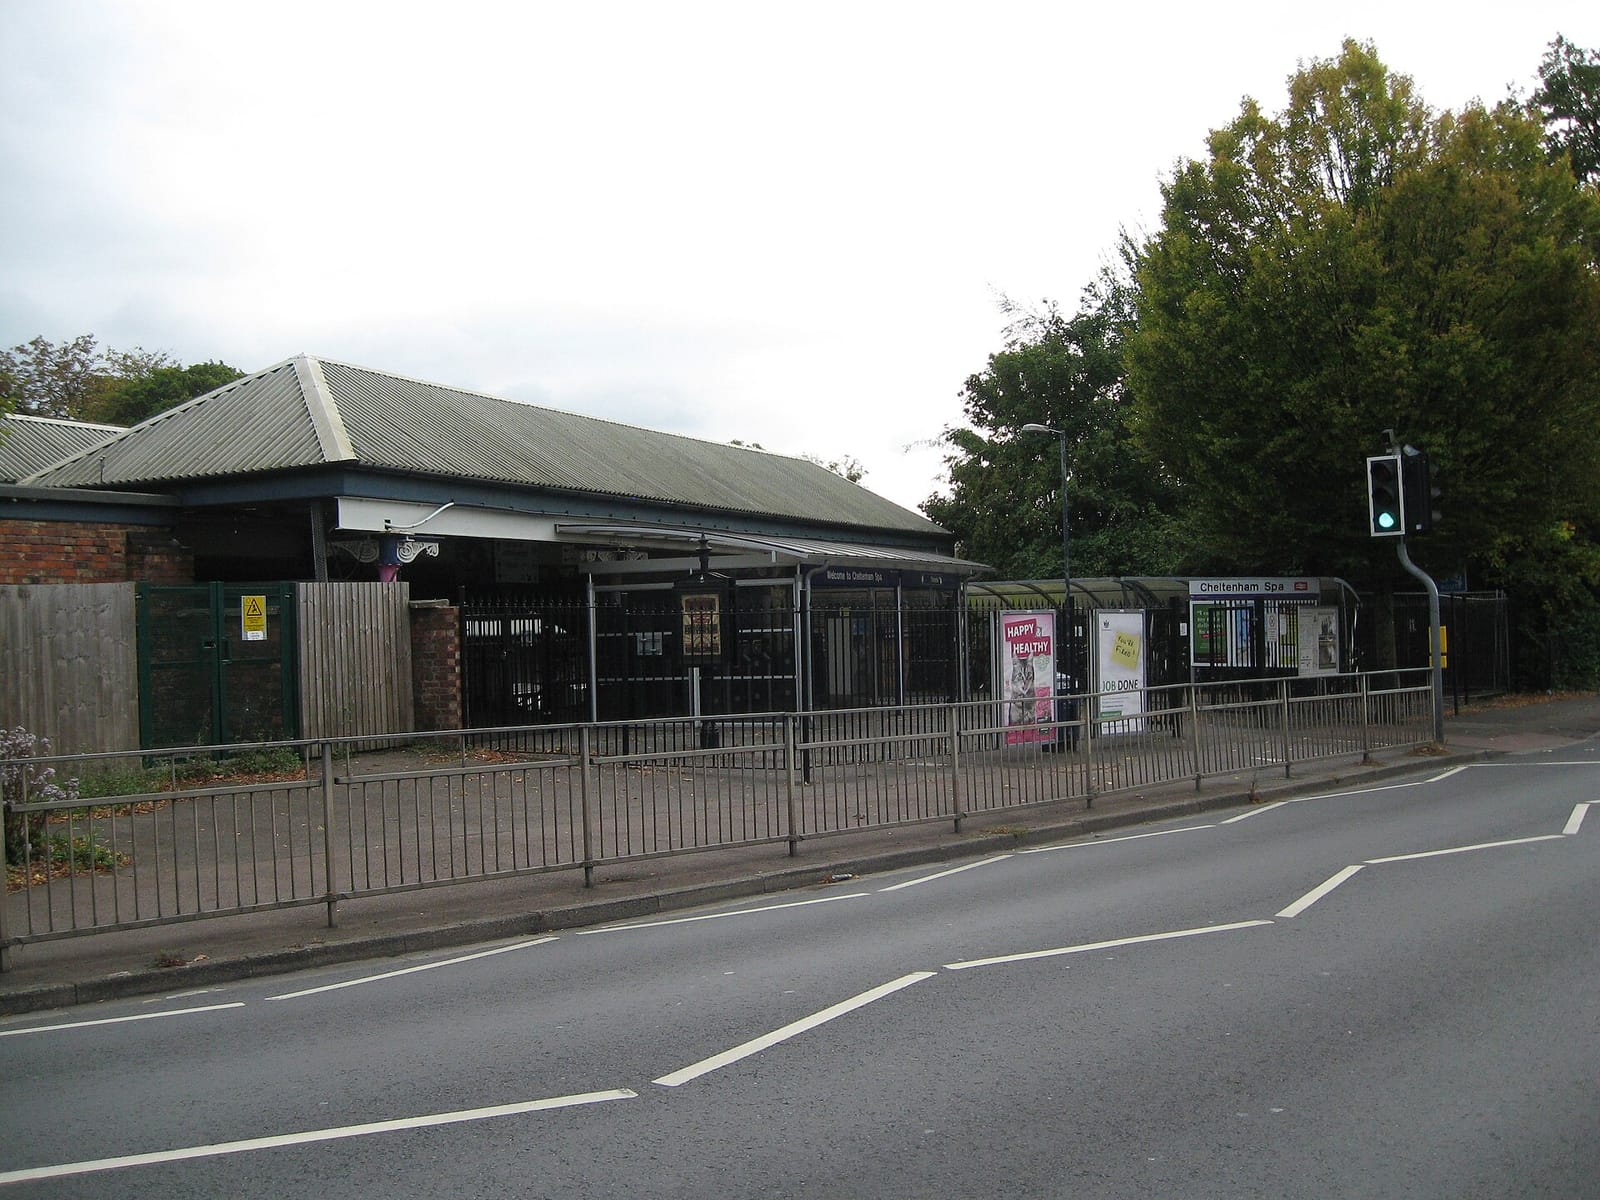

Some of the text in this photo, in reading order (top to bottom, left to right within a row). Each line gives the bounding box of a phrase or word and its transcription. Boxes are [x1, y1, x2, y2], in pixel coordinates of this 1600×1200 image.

[1200, 582, 1284, 593] Cheltenham Spa
[1007, 623, 1042, 638] HAPPY &
[1013, 641, 1049, 654] HEALTHY
[1102, 679, 1139, 692] JOB DONE
